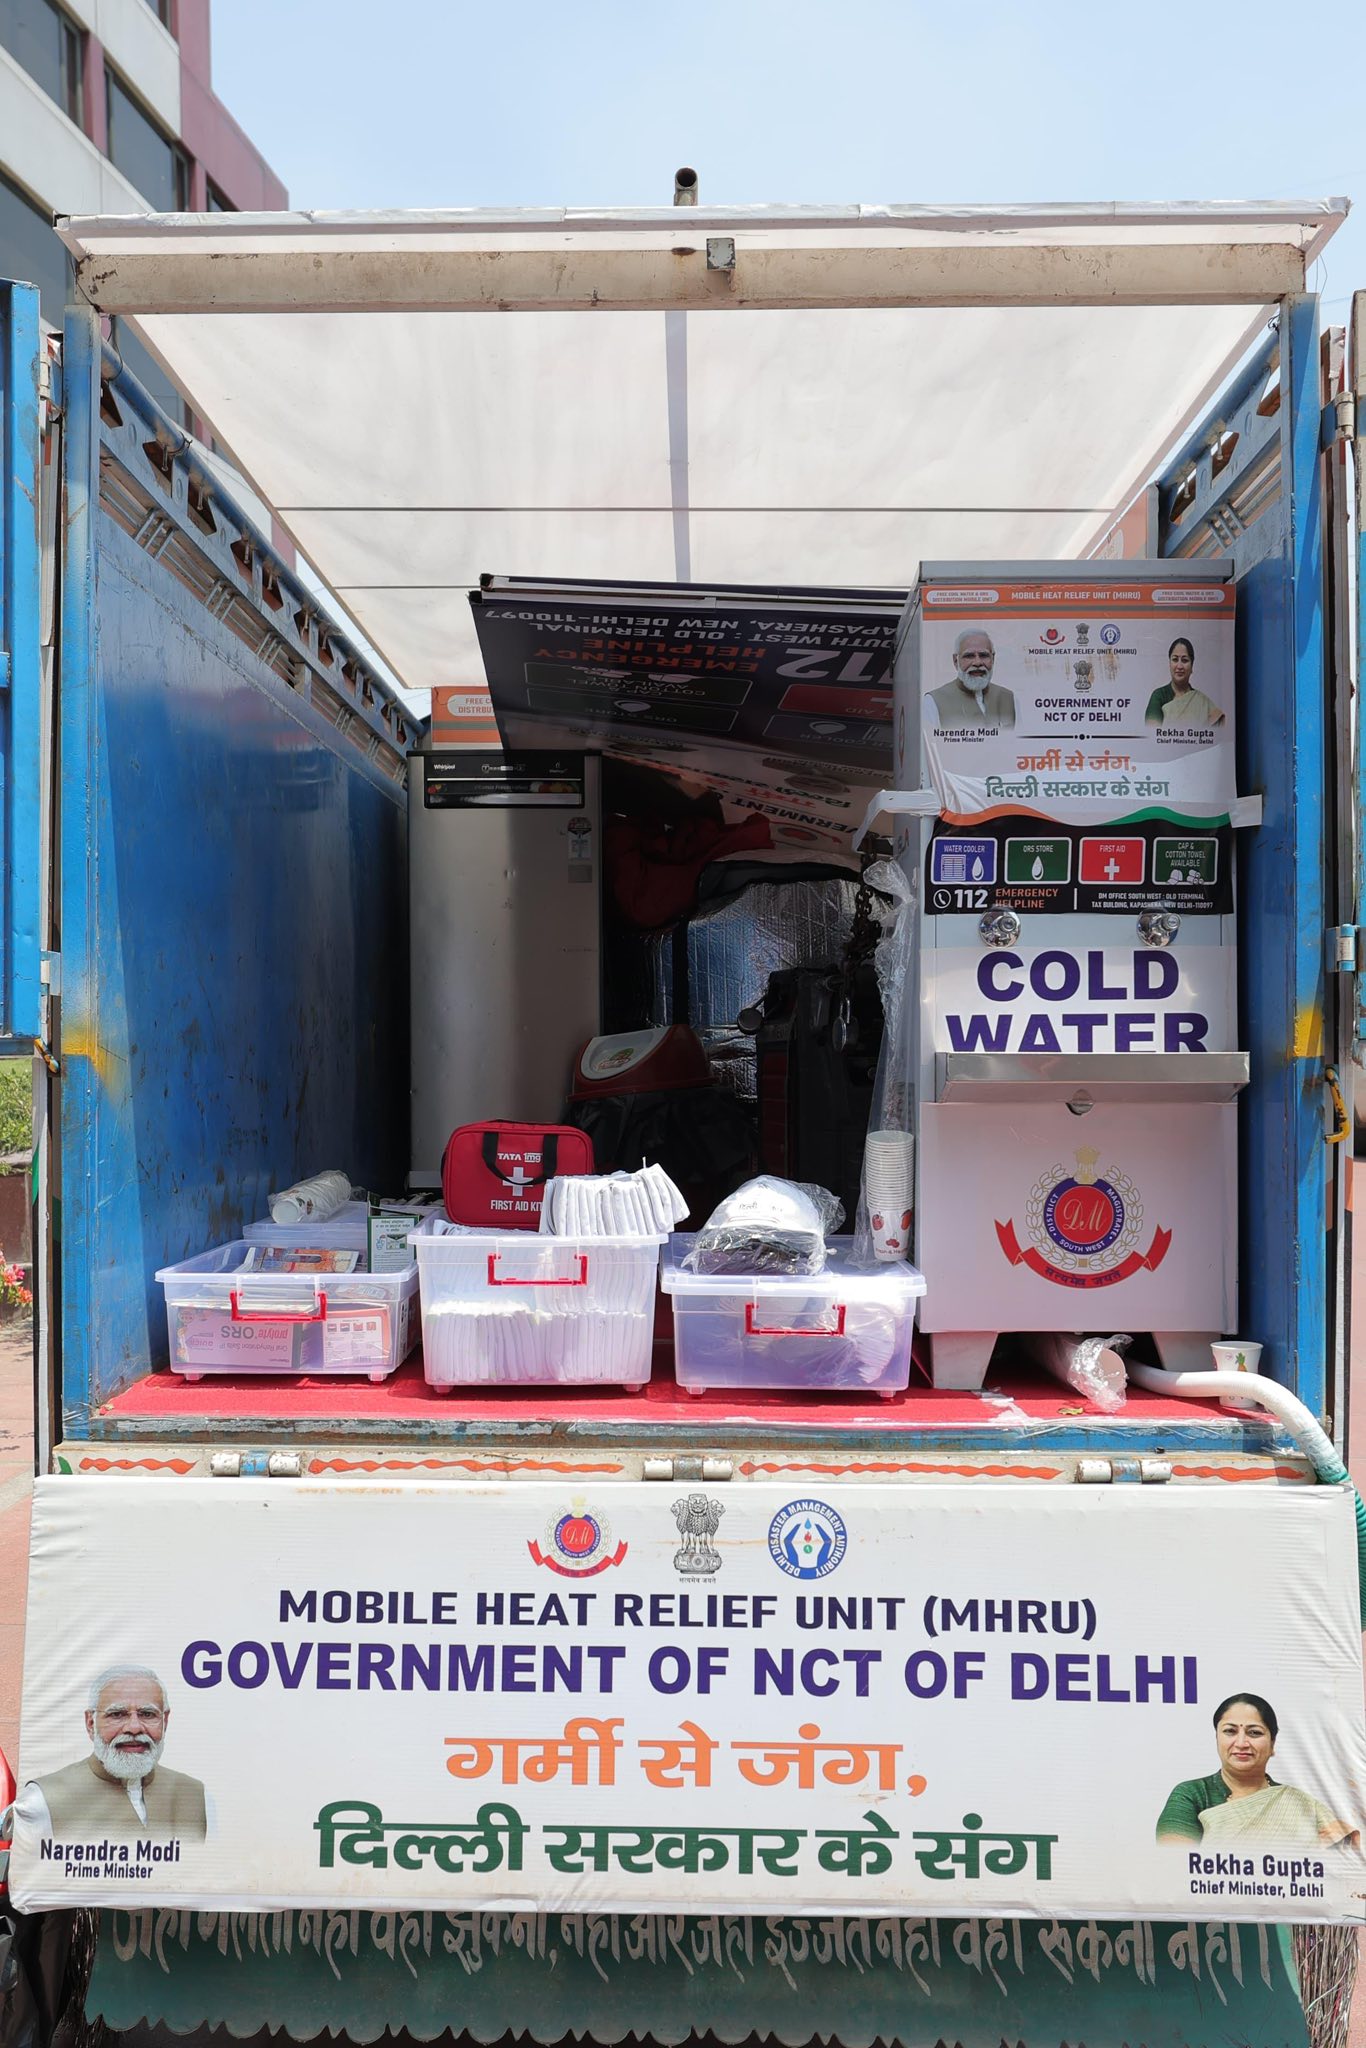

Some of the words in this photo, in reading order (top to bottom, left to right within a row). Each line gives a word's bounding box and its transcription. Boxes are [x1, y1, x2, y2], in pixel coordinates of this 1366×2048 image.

[1011, 592, 1040, 600] MOBILE
[1042, 592, 1062, 600] HEAT
[1112, 591, 1140, 600] (MHRU)
[484, 609, 669, 628] DELHI-110097
[677, 617, 739, 630] NEW
[528, 622, 664, 639] TERMINAL
[673, 629, 725, 642] OLD
[749, 620, 896, 636] APASHERA,
[747, 633, 821, 646] WEST
[831, 636, 893, 649] OUTH
[582, 638, 766, 659] HELPLINE
[1114, 648, 1137, 656] (MHRU)
[533, 647, 759, 673] EMERGENCY
[458, 706, 495, 714] DISTRBU
[1034, 698, 1113, 708] GOVERNMENT
[1116, 698, 1130, 708] OF
[1044, 712, 1068, 722] NCT
[1070, 712, 1085, 721] OF
[1088, 712, 1122, 721] DELHI
[934, 728, 975, 737] Narendra
[978, 728, 998, 736] Modi
[1156, 728, 1184, 737] Rekha
[1187, 729, 1214, 740] Gupta
[434, 764, 456, 772] Whirlpool
[1016, 749, 1062, 772] गर्मी
[1065, 750, 1085, 772] से
[1088, 750, 1136, 773] जंग,
[985, 776, 1040, 798] दिल्ली
[1042, 781, 1108, 797] सरकार
[1110, 776, 1131, 796] के
[1134, 776, 1170, 796] संग
[944, 845, 962, 853] WATER
[964, 845, 986, 853] COOLER
[1178, 842, 1190, 850] CAP
[954, 888, 988, 908] 112
[995, 888, 1058, 898] EMERGENCY
[1098, 892, 1108, 900] DM
[1108, 892, 1127, 900] OFFICE
[1128, 892, 1146, 900] SOUTH
[1146, 892, 1162, 900] WEST
[994, 899, 1045, 908] HELPLINE
[977, 950, 1180, 1002] COLD
[946, 1012, 1210, 1052] WATER
[490, 1200, 514, 1211] FIRST
[514, 1200, 528, 1211] AID
[1046, 1193, 1060, 1233] DISTRICT
[1106, 1188, 1123, 1238] MAGISTRATE
[1059, 1239, 1084, 1252] SOUTH
[1084, 1240, 1106, 1252] WEST
[221, 1326, 254, 1339] ORS
[258, 1328, 288, 1339] prolyte
[790, 1501, 844, 1535] MANAGEMENT
[770, 1511, 789, 1556] DISASTER
[816, 1534, 846, 1578] AUTHORITY
[778, 1558, 800, 1578] DELHI
[280, 1590, 457, 1624] MOBILE
[477, 1593, 597, 1626] HEAT
[615, 1594, 777, 1628] RELIEF
[796, 1596, 905, 1630] UNIT
[923, 1595, 1096, 1641] (MHRU)
[181, 1640, 626, 1693] GOVERNMENT
[648, 1646, 729, 1694] OF
[754, 1648, 882, 1697] NCT
[905, 1650, 985, 1699] OF
[1011, 1653, 1198, 1704] DELHI
[444, 1718, 624, 1785] गर्मी
[638, 1721, 719, 1788] से
[731, 1723, 927, 1797] जंग,
[313, 1801, 530, 1873] दिल्ली
[543, 1825, 808, 1876] सरकार
[815, 1810, 899, 1876] के
[913, 1813, 1058, 1880] संग
[41, 1839, 128, 1861] Narendra
[136, 1836, 180, 1862] Modi
[65, 1862, 100, 1878] Prime
[104, 1863, 153, 1878] Minister
[1189, 1853, 1254, 1875] Rekha
[1263, 1855, 1324, 1883] Gupta
[1191, 1880, 1224, 1894] Chief
[1229, 1881, 1285, 1899] Minister,
[1290, 1879, 1323, 1897] Delhi
